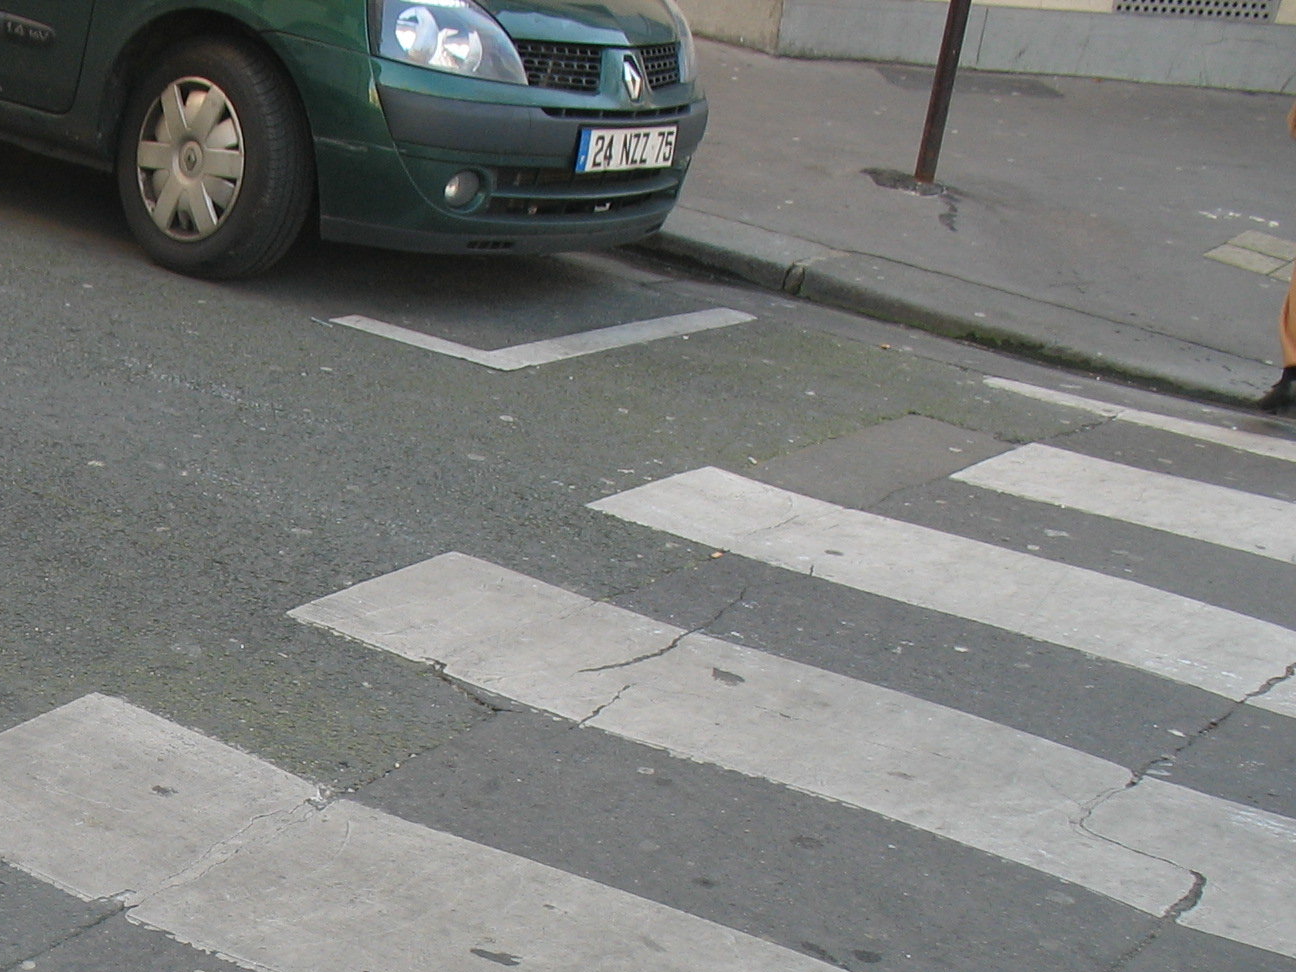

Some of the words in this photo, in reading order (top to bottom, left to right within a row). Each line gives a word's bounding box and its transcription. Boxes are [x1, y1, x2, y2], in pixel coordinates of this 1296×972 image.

[6, 21, 24, 37] 14
[592, 134, 614, 168] 24
[619, 131, 651, 165] NZZ
[654, 130, 675, 164] 75
